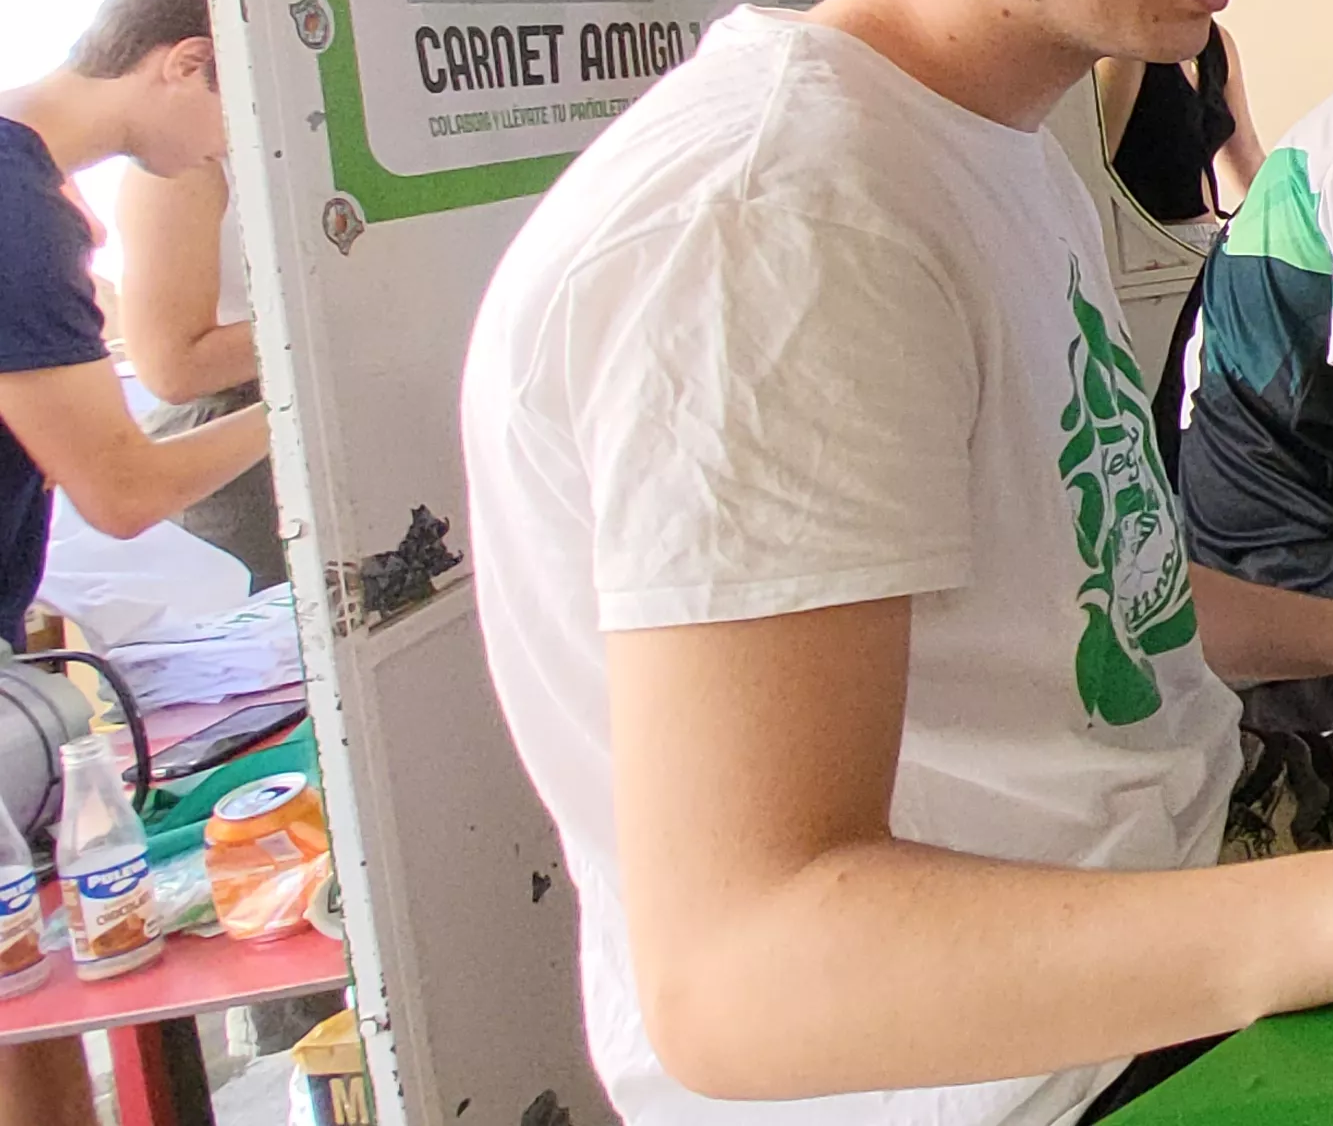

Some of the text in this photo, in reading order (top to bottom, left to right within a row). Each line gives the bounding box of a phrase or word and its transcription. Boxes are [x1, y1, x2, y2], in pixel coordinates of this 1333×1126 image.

[415, 21, 686, 94] CARNET AMIGO
[551, 103, 566, 123] TU
